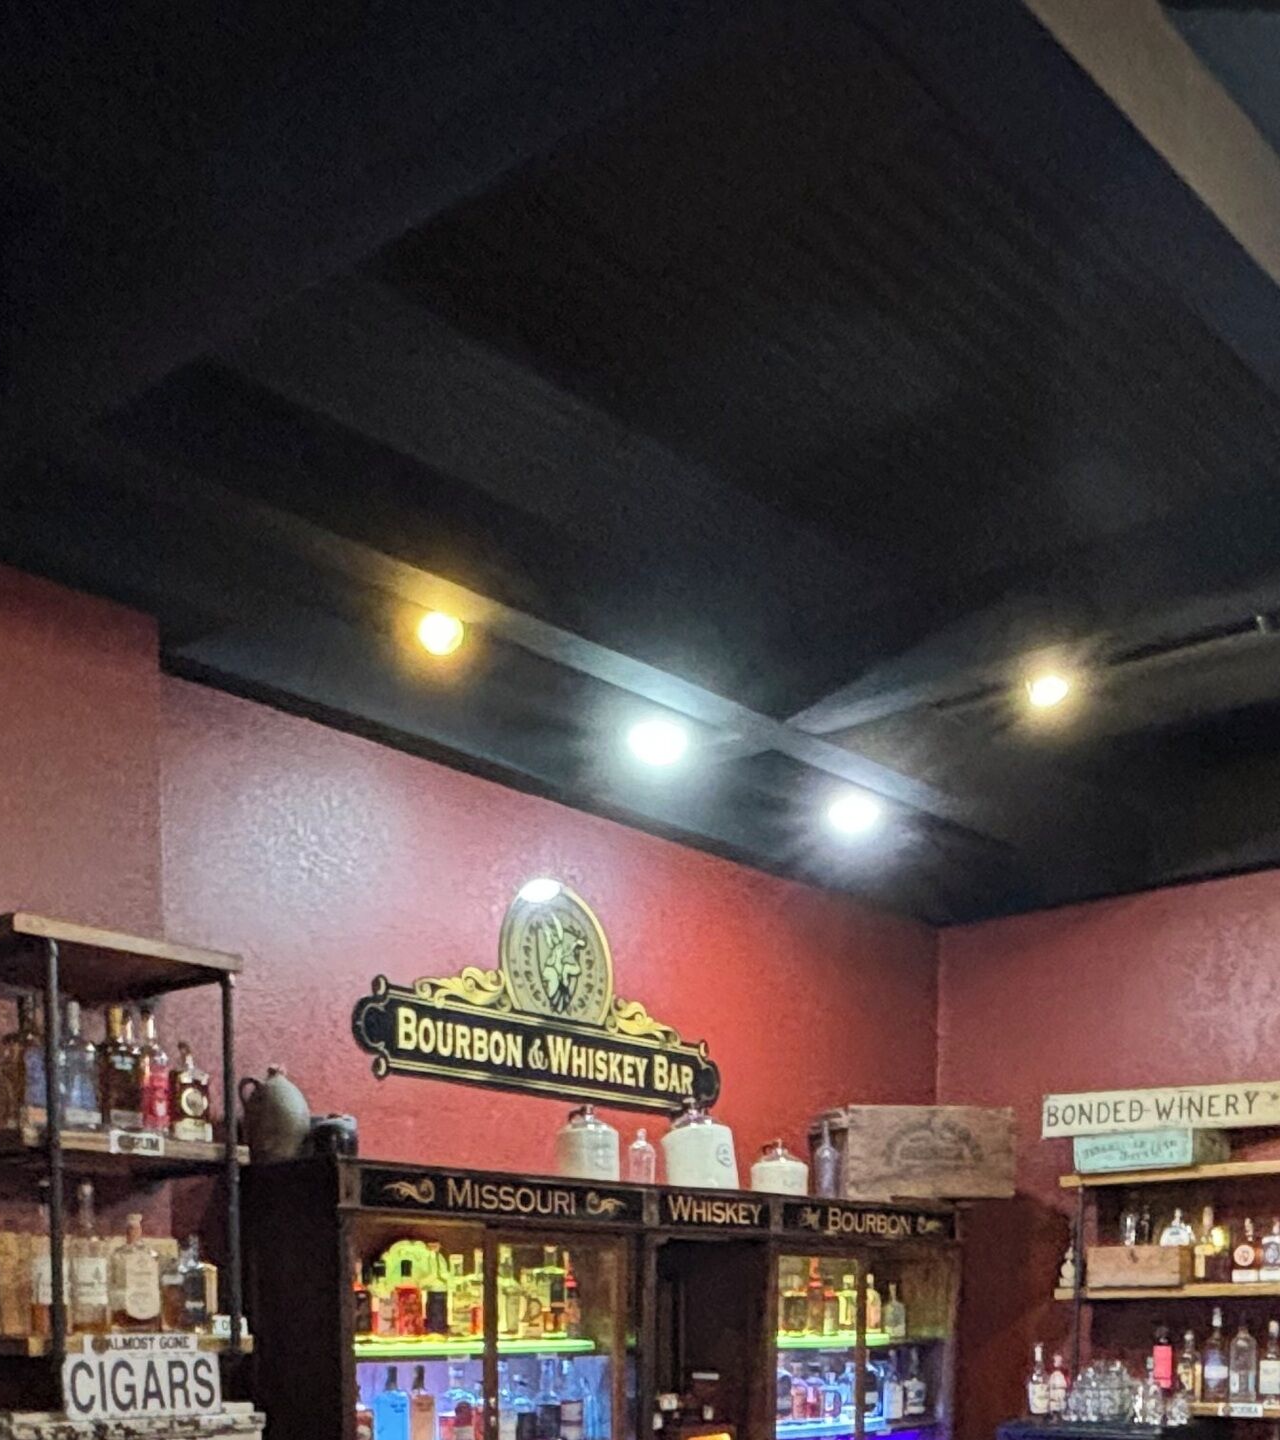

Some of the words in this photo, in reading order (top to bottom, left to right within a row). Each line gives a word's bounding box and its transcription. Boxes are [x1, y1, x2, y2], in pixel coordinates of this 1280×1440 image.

[397, 1007, 524, 1070] BOURBON
[527, 1038, 550, 1072] &
[546, 1036, 648, 1088] WHISKEY
[653, 1055, 694, 1096] BAR
[447, 1178, 576, 1216] MISSOURI
[668, 1195, 762, 1225] WHISKEY
[828, 1206, 912, 1235] BOURBON
[159, 1336, 191, 1350] GONE
[70, 1358, 215, 1414] CIGARS
